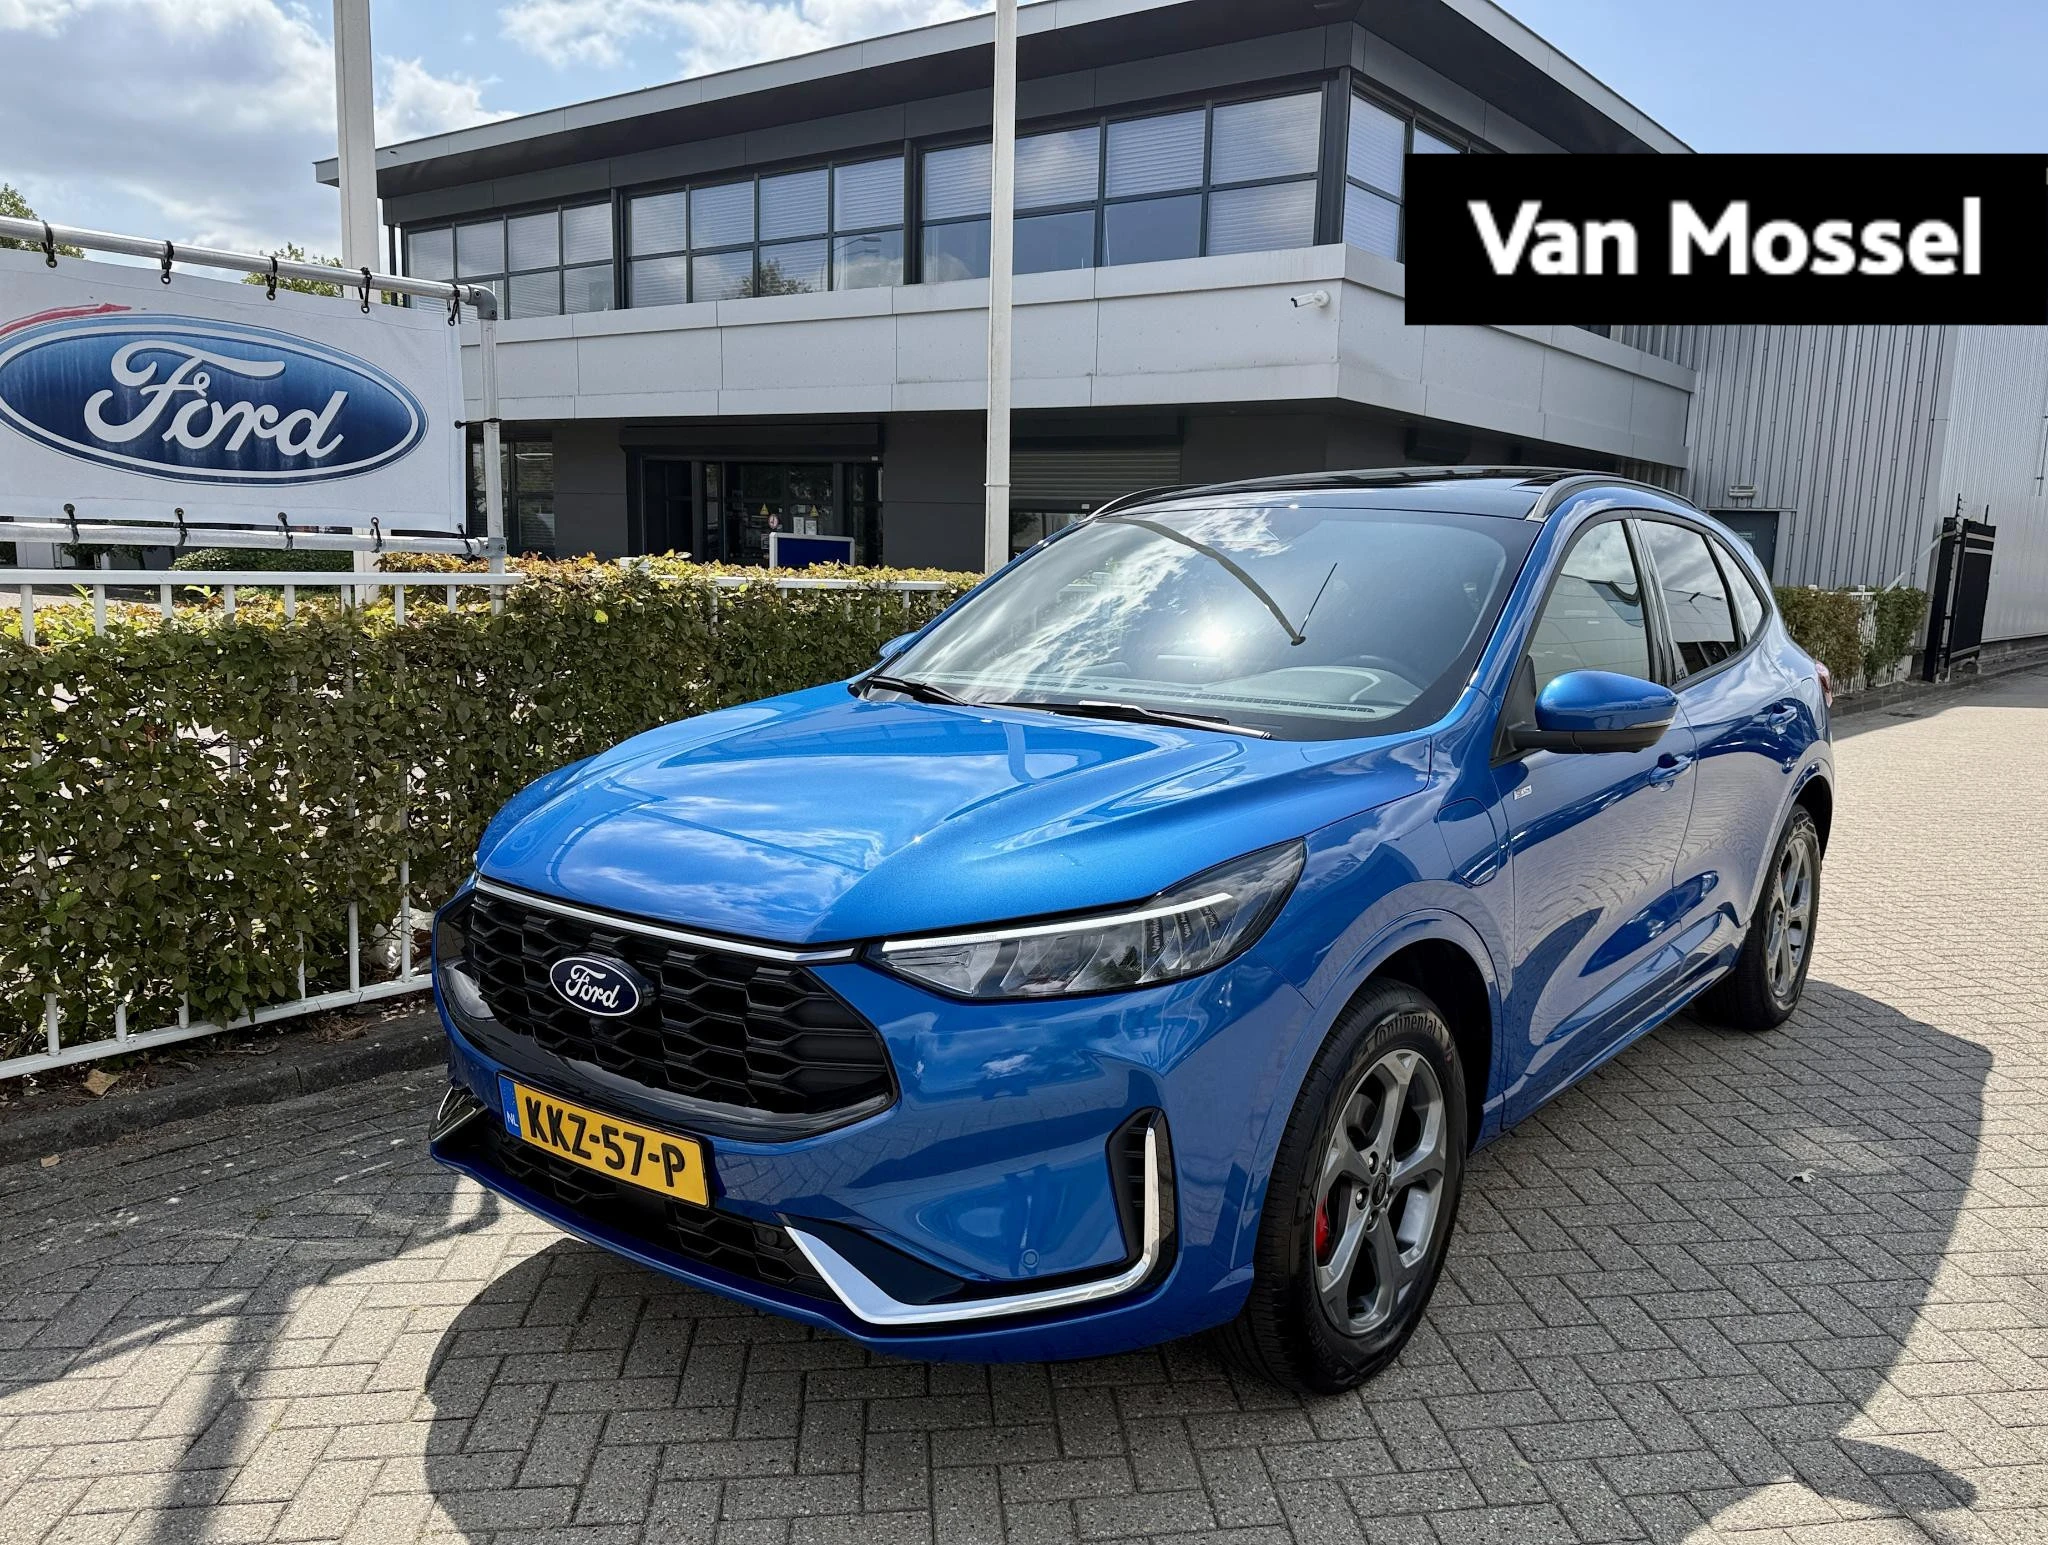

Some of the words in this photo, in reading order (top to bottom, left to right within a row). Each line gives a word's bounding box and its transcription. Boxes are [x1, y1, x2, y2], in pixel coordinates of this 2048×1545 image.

[84, 340, 348, 459] Ford
[565, 964, 620, 1008] Ford
[1374, 1013, 1438, 1047] Continental
[506, 1110, 519, 1127] NL
[525, 1096, 685, 1187] KKZ-57-P
